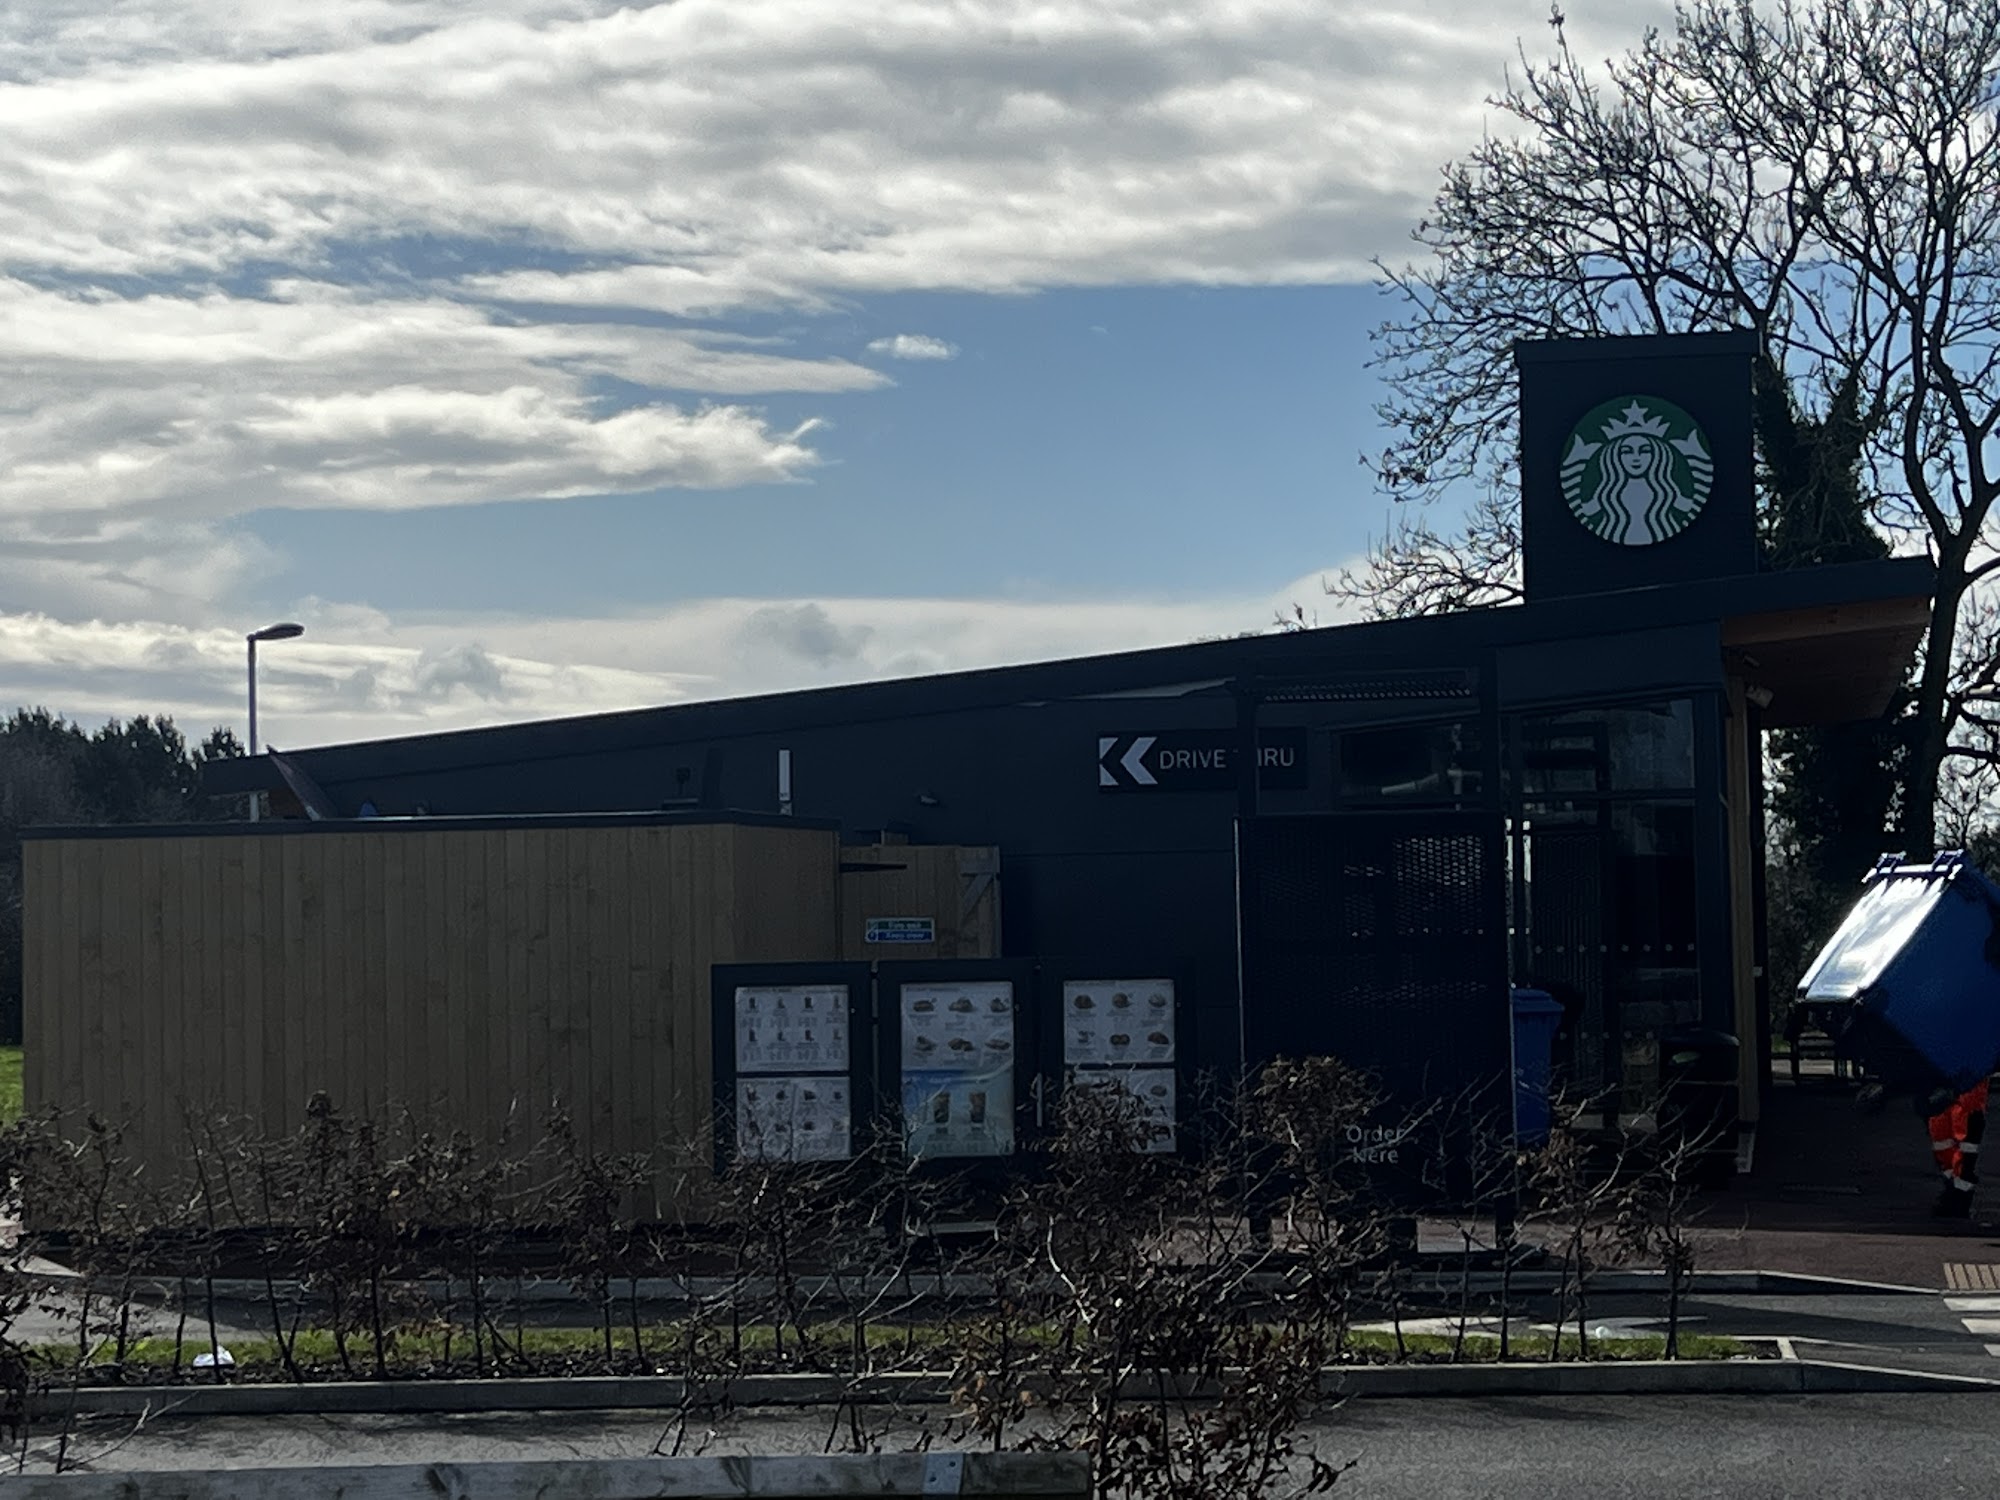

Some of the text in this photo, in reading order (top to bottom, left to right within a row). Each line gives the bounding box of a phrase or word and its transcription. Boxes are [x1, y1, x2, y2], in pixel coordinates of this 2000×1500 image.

[1159, 747, 1295, 770] DRIVE RU
[1346, 1124, 1403, 1143] Order
